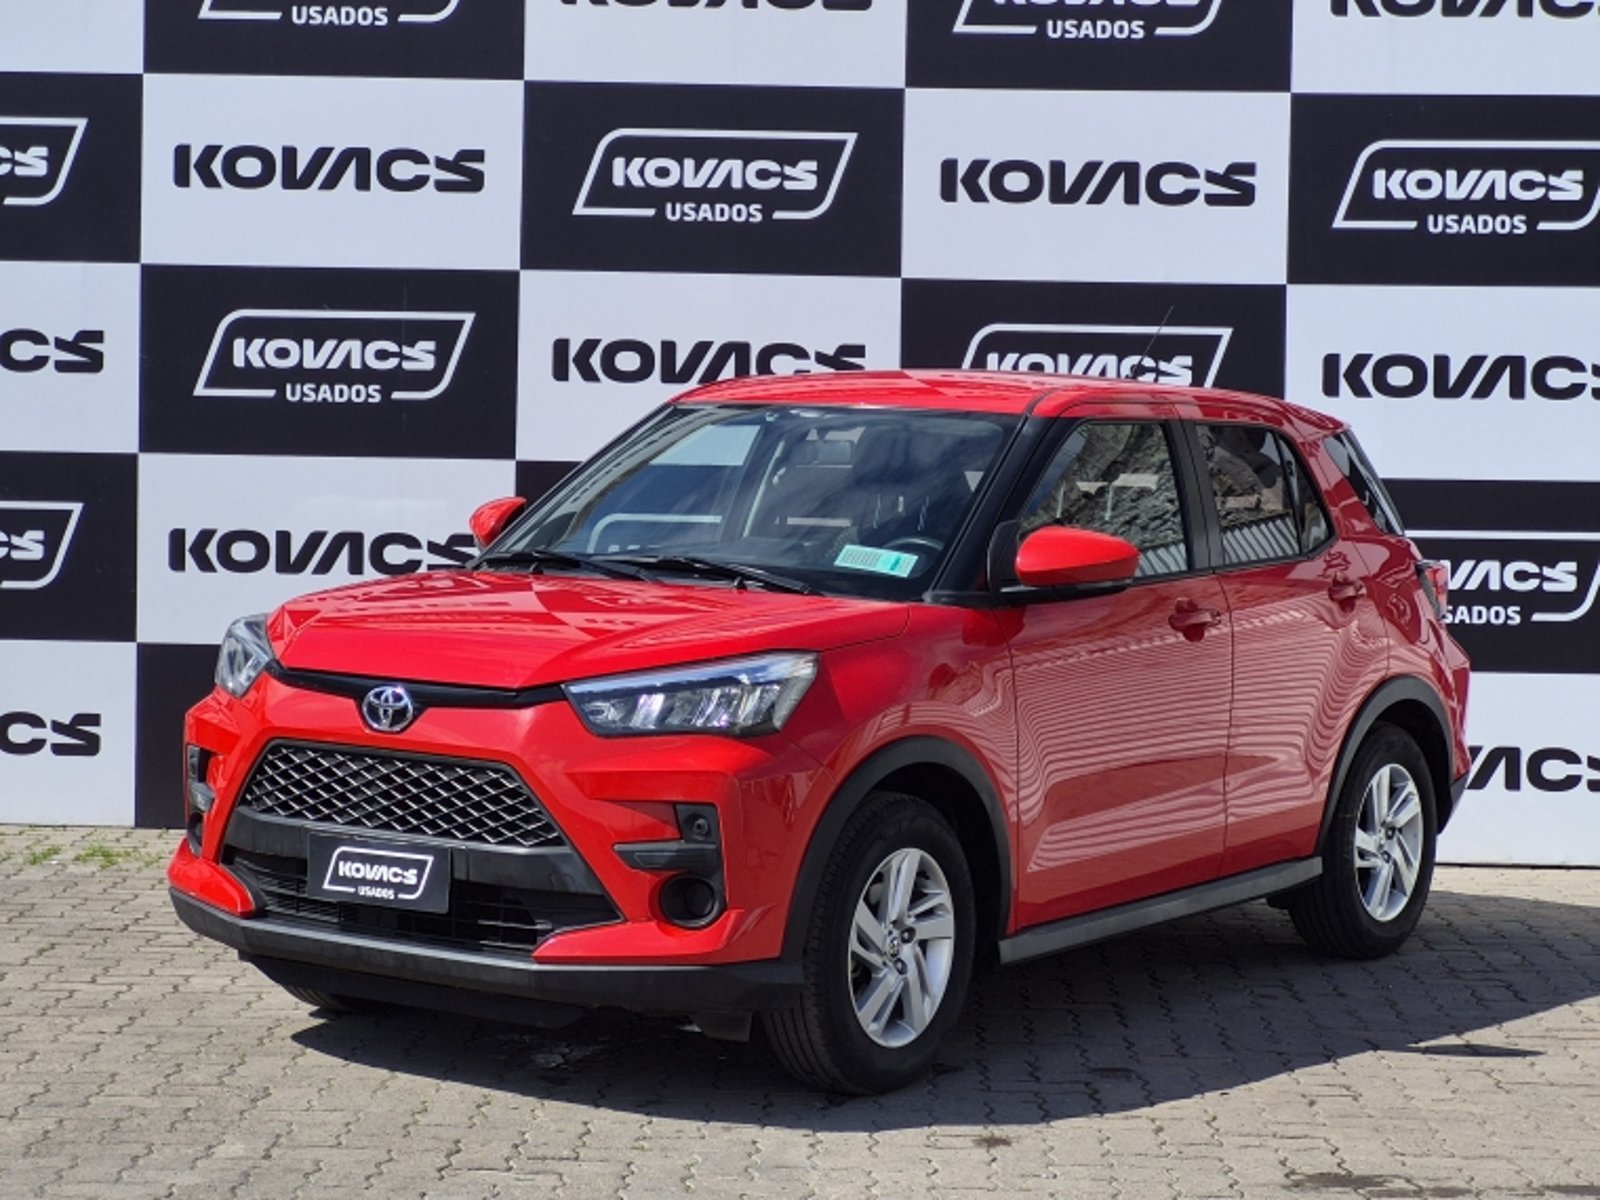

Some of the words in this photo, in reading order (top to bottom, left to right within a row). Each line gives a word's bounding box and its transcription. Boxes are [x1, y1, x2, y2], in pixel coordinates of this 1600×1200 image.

[291, 6, 388, 26] USADOS
[1047, 19, 1145, 39] USADOS
[174, 144, 485, 193] KOVACS
[612, 156, 818, 191] KOVACS
[940, 158, 1256, 206] KOVACS
[1373, 167, 1584, 201] KOVACS
[665, 202, 763, 223] USADOS
[1427, 214, 1527, 235] USADOS
[233, 338, 436, 371] KOVACS
[1322, 353, 1600, 400] KOVAC
[285, 383, 382, 404] USADOS
[1440, 559, 1578, 592] VACS
[1442, 605, 1521, 626] SADOS
[338, 860, 419, 885] KOVACS
[357, 885, 395, 900] USADOS
